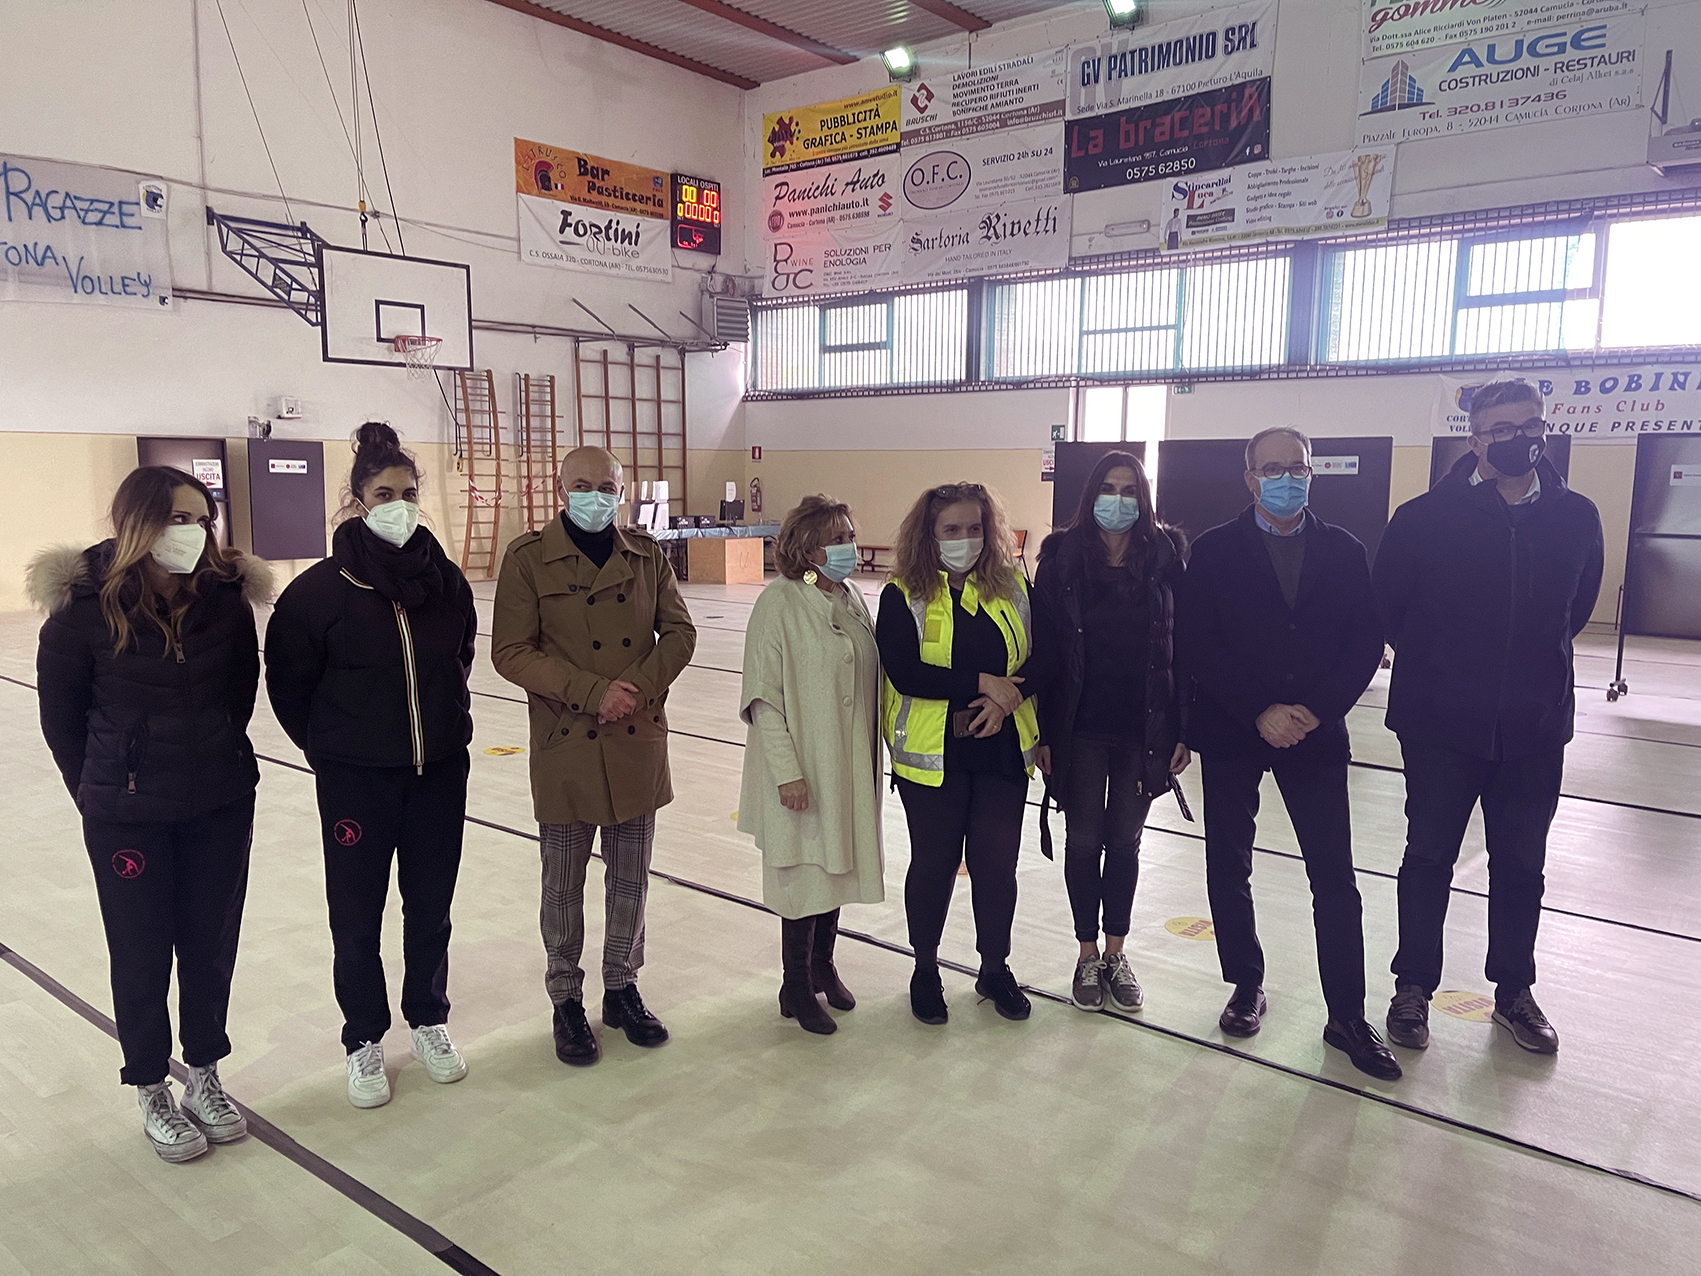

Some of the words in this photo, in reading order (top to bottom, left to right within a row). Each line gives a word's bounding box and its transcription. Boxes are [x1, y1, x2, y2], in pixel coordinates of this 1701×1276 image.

[1414, 28, 1431, 36] Alice
[1434, 21, 1465, 32] Ricciardi
[1466, 18, 1481, 26] Von
[1483, 13, 1508, 23] Platen
[1514, 7, 1538, 18] 52044
[1540, 2, 1575, 13] Camucia
[1385, 42, 1404, 50] 0575
[1421, 36, 1435, 44] 620
[1459, 28, 1478, 38] 0575
[1480, 25, 1494, 34] 190
[1495, 23, 1509, 31] 201
[1447, 24, 1607, 73] AUGE
[1081, 58, 1102, 87] GV
[1107, 31, 1218, 81] PATRIMONIO
[1224, 22, 1258, 56] SRL
[952, 72, 977, 82] LAVORI
[998, 57, 1034, 72] STRADALI
[1438, 64, 1540, 92] COSTRUZIONI
[1553, 49, 1636, 75] RESTAURI
[952, 75, 999, 91] DEMOLIZIONI
[952, 84, 996, 99] MOVIMENTO
[997, 79, 1020, 89] TERRA
[952, 95, 988, 107] RECUPERO
[990, 88, 1014, 100] RIFIUTI
[1016, 83, 1039, 95] INERTI
[1076, 104, 1095, 114] Sede
[1097, 101, 1108, 110] Via
[1116, 91, 1153, 106] Marinella
[1155, 89, 1165, 98] 18
[1171, 84, 1196, 96] 67100
[1197, 76, 1228, 90] Preturo
[1229, 68, 1263, 81] L'Aquila
[820, 104, 881, 132] PUBBLICITÀ
[952, 104, 989, 117] BONIFICHE
[990, 97, 1024, 110] AMIANTO
[906, 113, 938, 126] BRUSCHI
[1447, 121, 1453, 131] 8
[803, 131, 847, 150] GRAFICA
[857, 120, 898, 140] STAMPA
[982, 153, 1015, 166] SERVIZIO
[1017, 151, 1029, 160] 24h
[1031, 149, 1042, 157] SU
[1044, 147, 1053, 156] 24
[1126, 165, 1155, 180] 0575
[1158, 157, 1196, 174] 62850
[576, 157, 610, 181] Bar
[677, 175, 699, 187] LOCALI
[911, 161, 963, 187] O.F.C.
[0, 161, 142, 230] RAGAZZE
[587, 181, 664, 208] Pasticceria
[773, 173, 838, 208] Panichi
[841, 167, 887, 197] Auto
[788, 197, 870, 218] www.panichiauto.it
[559, 209, 641, 247] Fortini
[908, 227, 970, 256] Sartoria
[978, 205, 1059, 246] Rivetti
[790, 258, 814, 267] WINE
[823, 257, 867, 269] ENOLOGIA
[824, 246, 869, 259] SOLUZIONI
[873, 243, 892, 254] PER
[945, 255, 960, 263] HAND
[962, 251, 989, 261] TAILORED
[997, 248, 1013, 256] ITALY
[0, 242, 59, 267] ONA
[63, 256, 152, 297] VOLLEY
[1551, 402, 1603, 415] Fans
[1616, 399, 1665, 412] Club
[1545, 422, 1599, 434] NQUE
[1610, 420, 1701, 432] PRESEN
